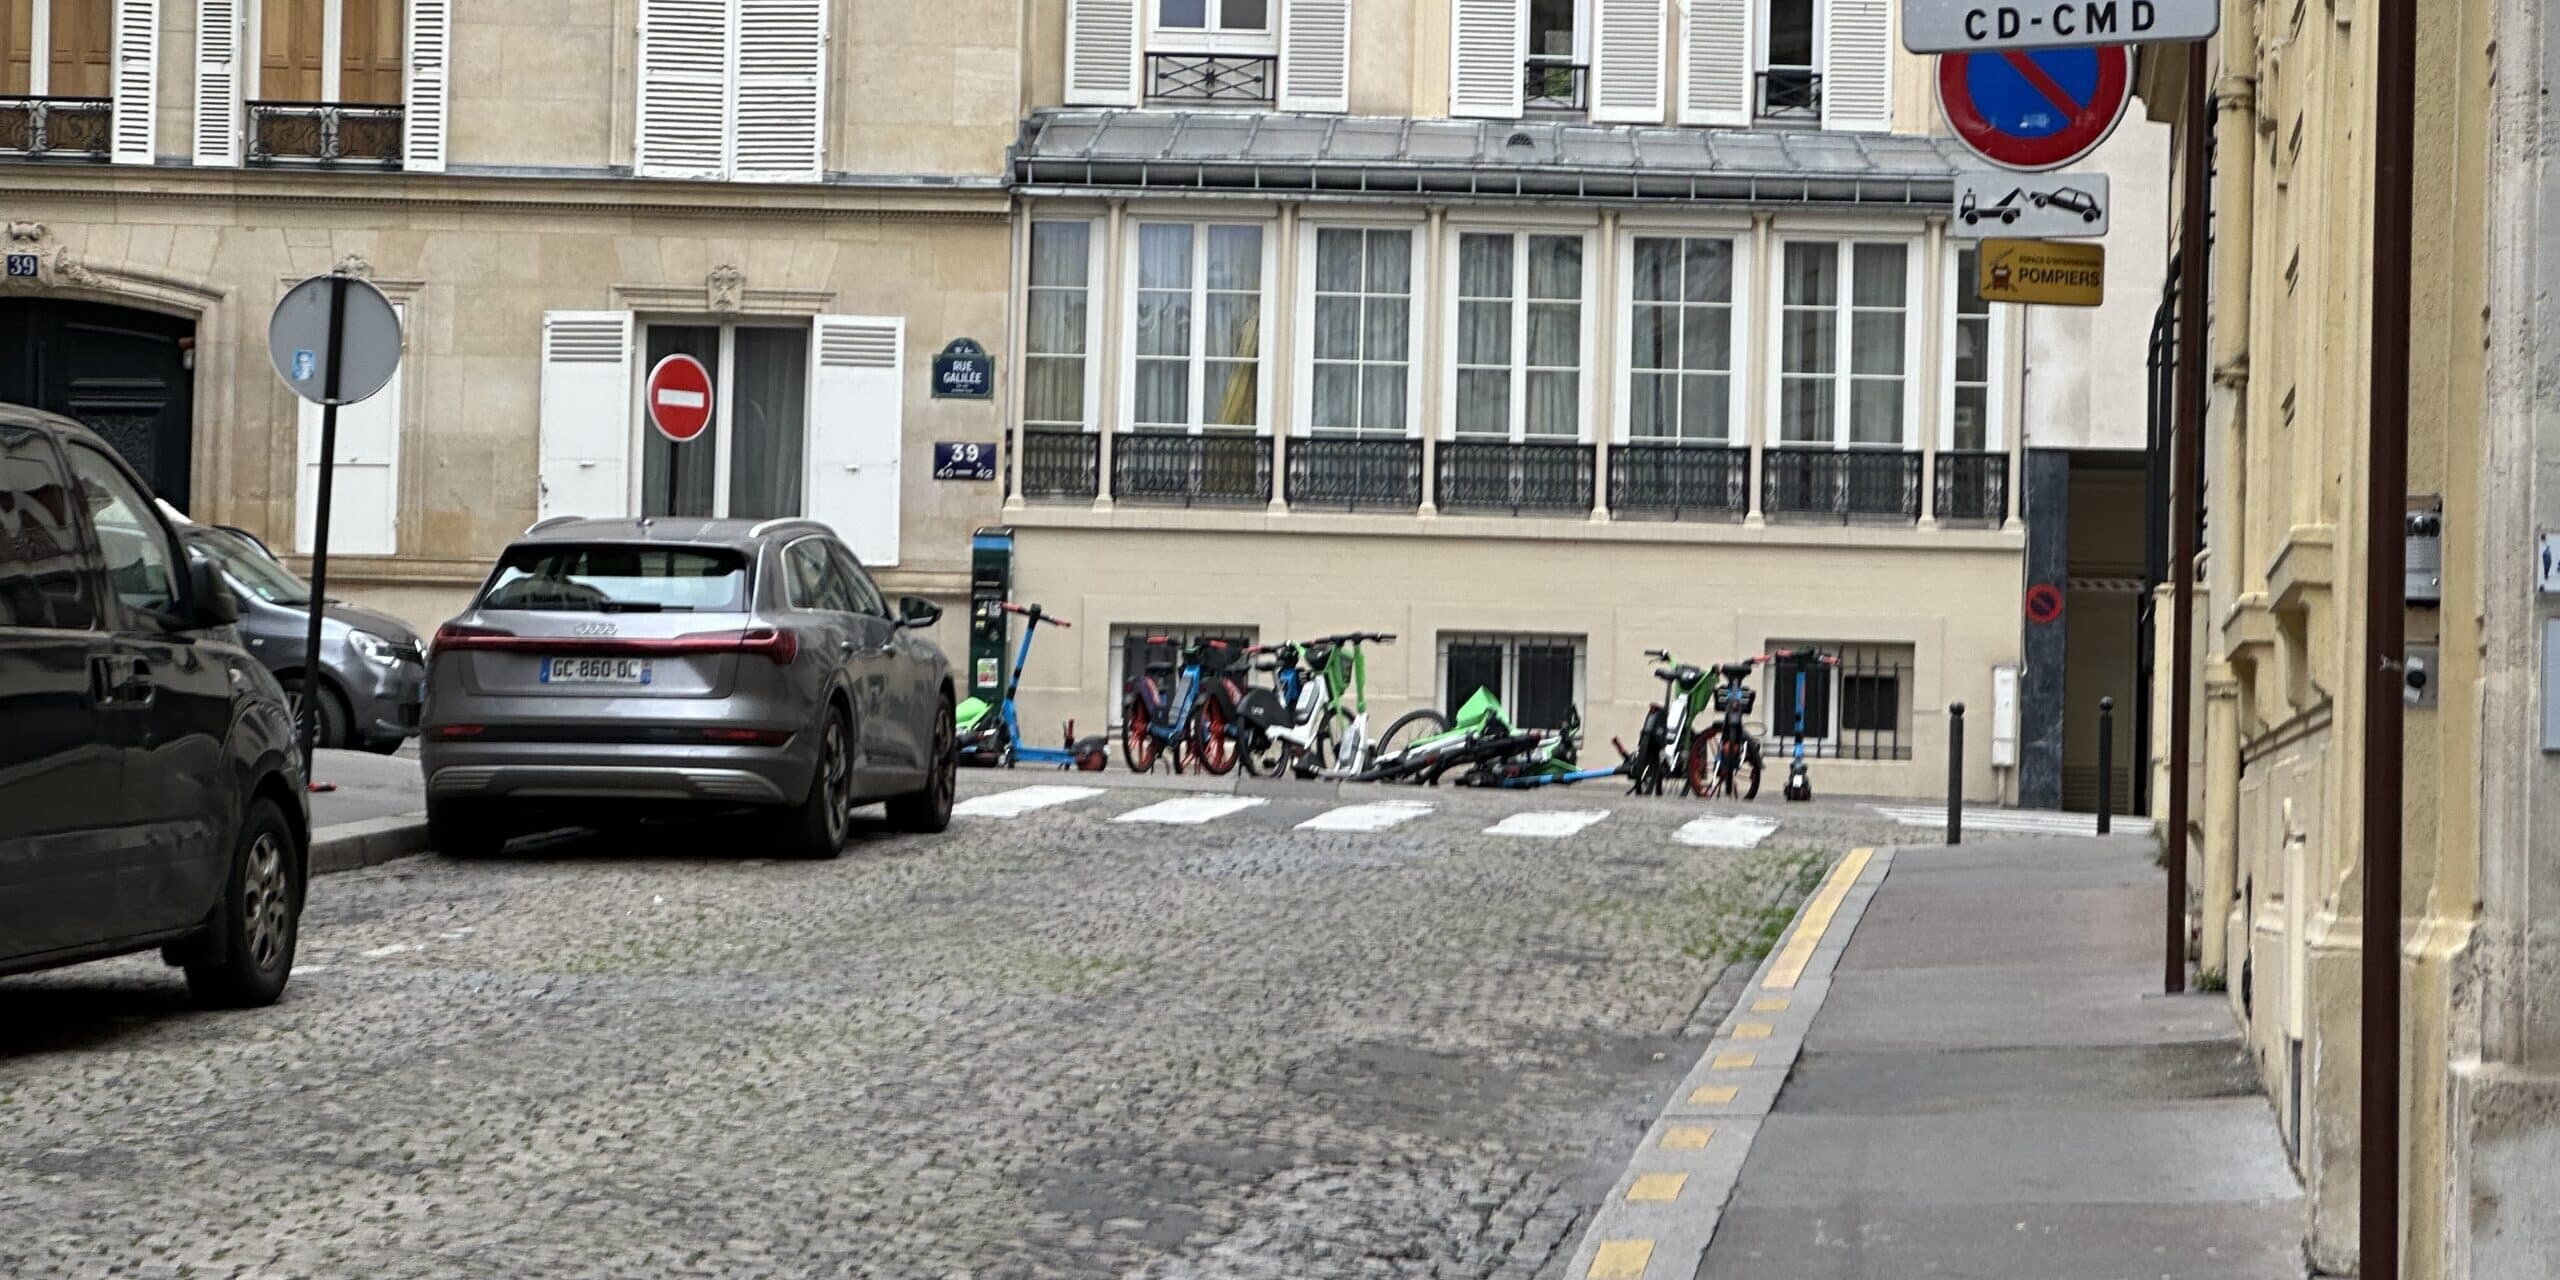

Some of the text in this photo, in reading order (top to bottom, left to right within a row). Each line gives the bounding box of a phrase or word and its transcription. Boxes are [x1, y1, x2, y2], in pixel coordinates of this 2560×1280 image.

[1964, 1, 2155, 41] CD-CMD
[10, 255, 35, 275] 39
[2018, 266, 2101, 289] POMPIERS
[952, 360, 974, 372] RUE
[943, 370, 983, 385] GALILÉE
[951, 443, 980, 463] 39
[936, 467, 994, 480] 40 42
